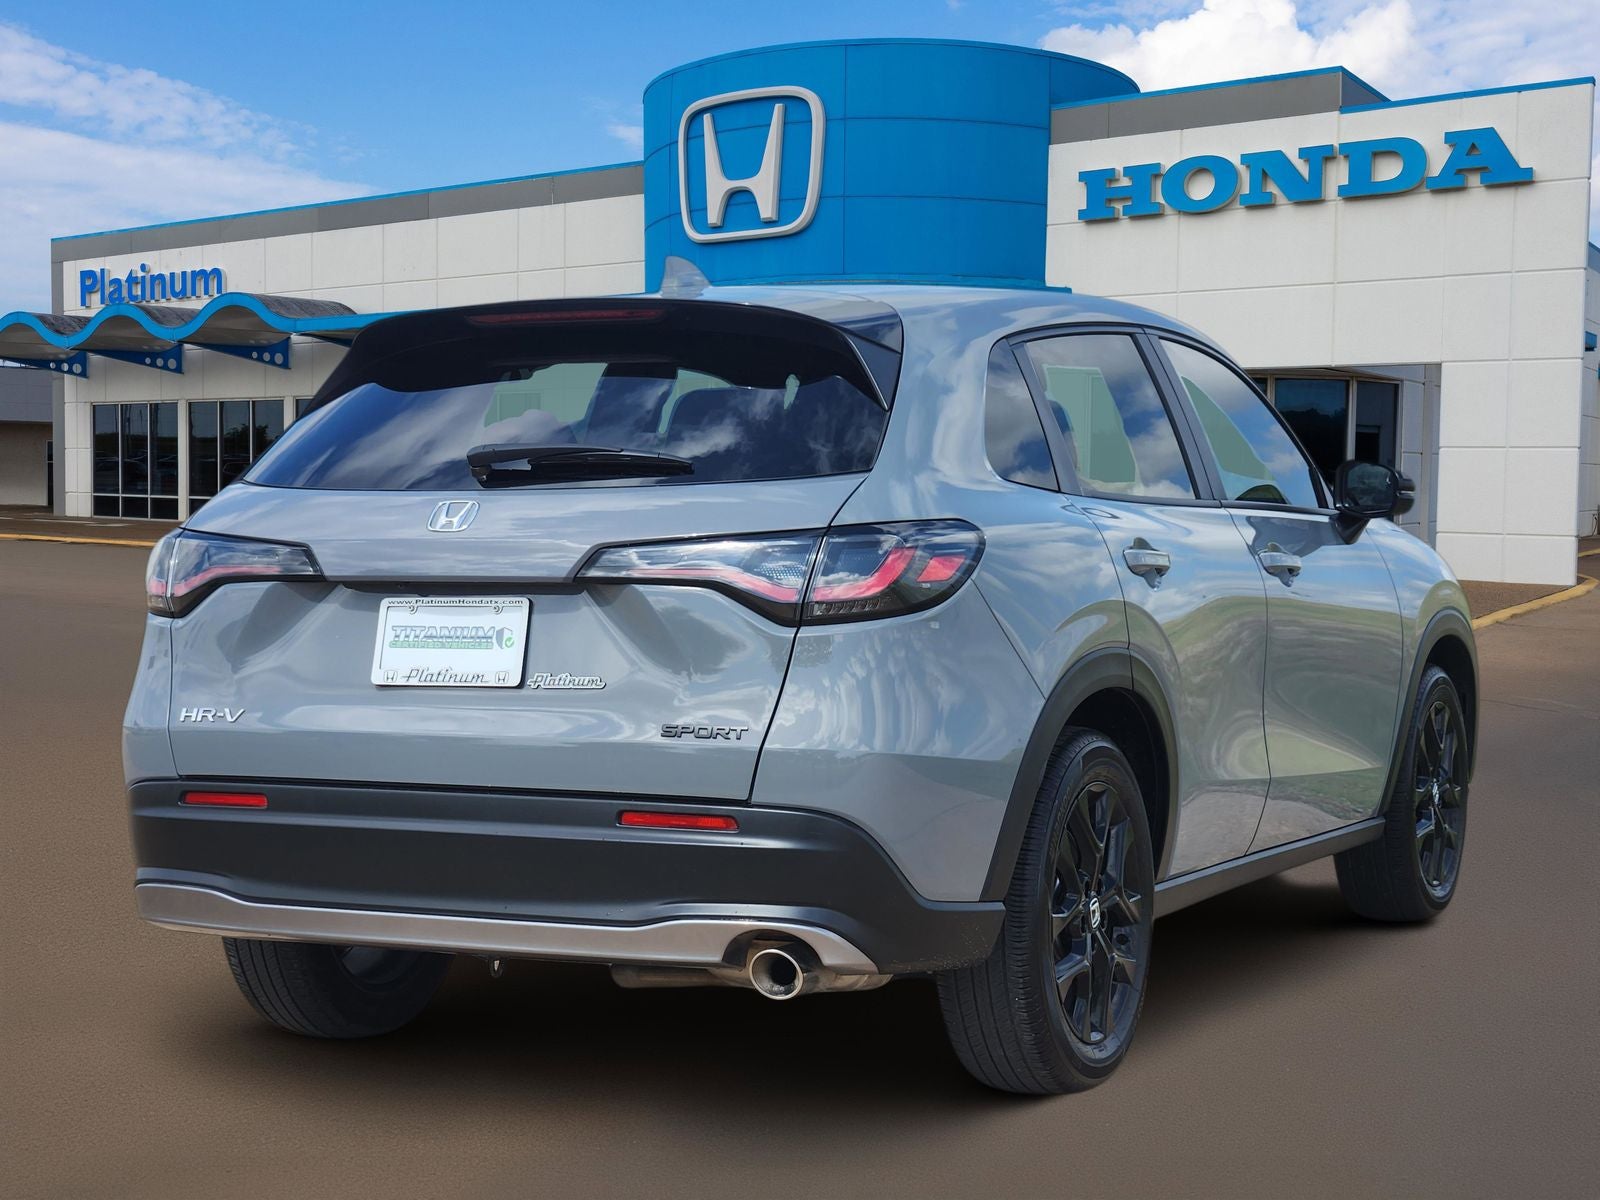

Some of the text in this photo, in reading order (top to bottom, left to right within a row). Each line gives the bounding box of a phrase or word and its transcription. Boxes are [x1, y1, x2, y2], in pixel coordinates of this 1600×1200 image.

[1078, 127, 1534, 222] HONDA
[79, 263, 224, 307] Platinum
[391, 625, 496, 642] TITANIUM
[389, 640, 494, 650] CERTIFIED VEHICLES
[401, 666, 490, 683] Platinum
[527, 672, 607, 690] Platinum
[179, 707, 246, 723] HR-V
[660, 723, 749, 740] SPORT
